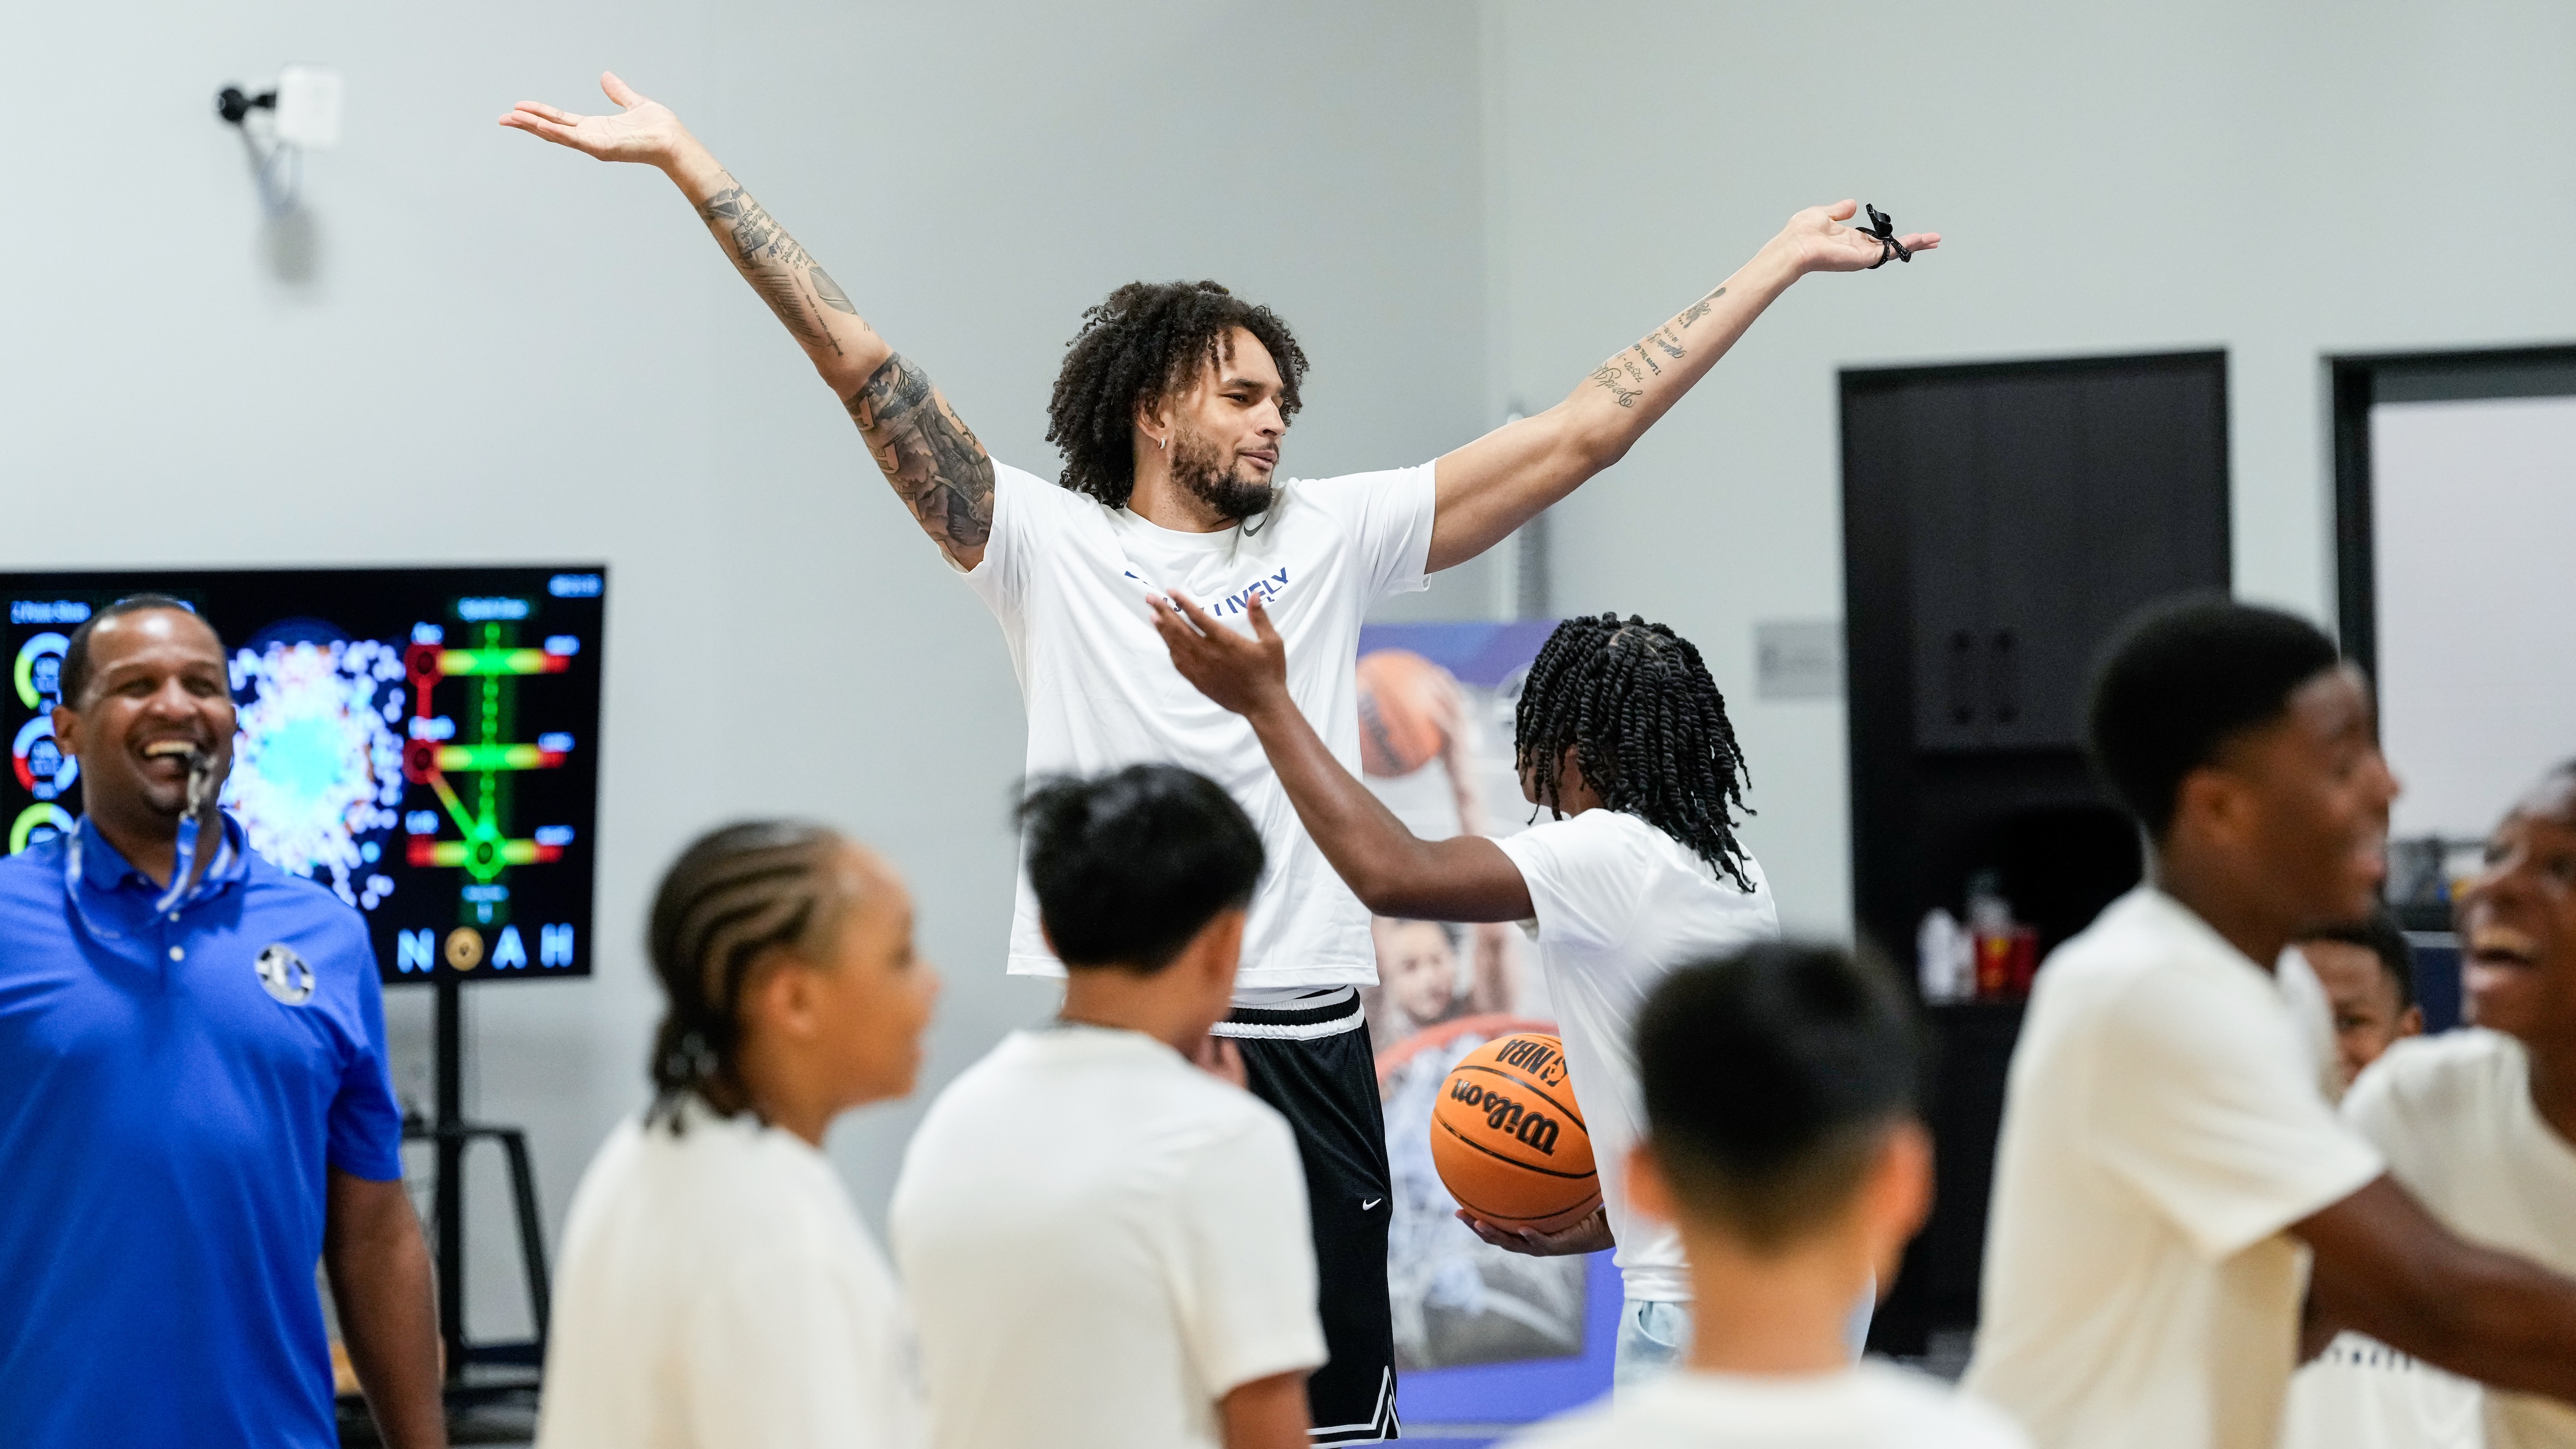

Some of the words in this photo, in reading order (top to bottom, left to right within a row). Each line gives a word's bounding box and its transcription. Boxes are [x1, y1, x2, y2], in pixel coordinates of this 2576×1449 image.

[1646, 357, 1658, 372] Love
[1596, 371, 1642, 407] Dereck
[1496, 1039, 1556, 1075] NBA
[1451, 1079, 1560, 1156] Wilson
